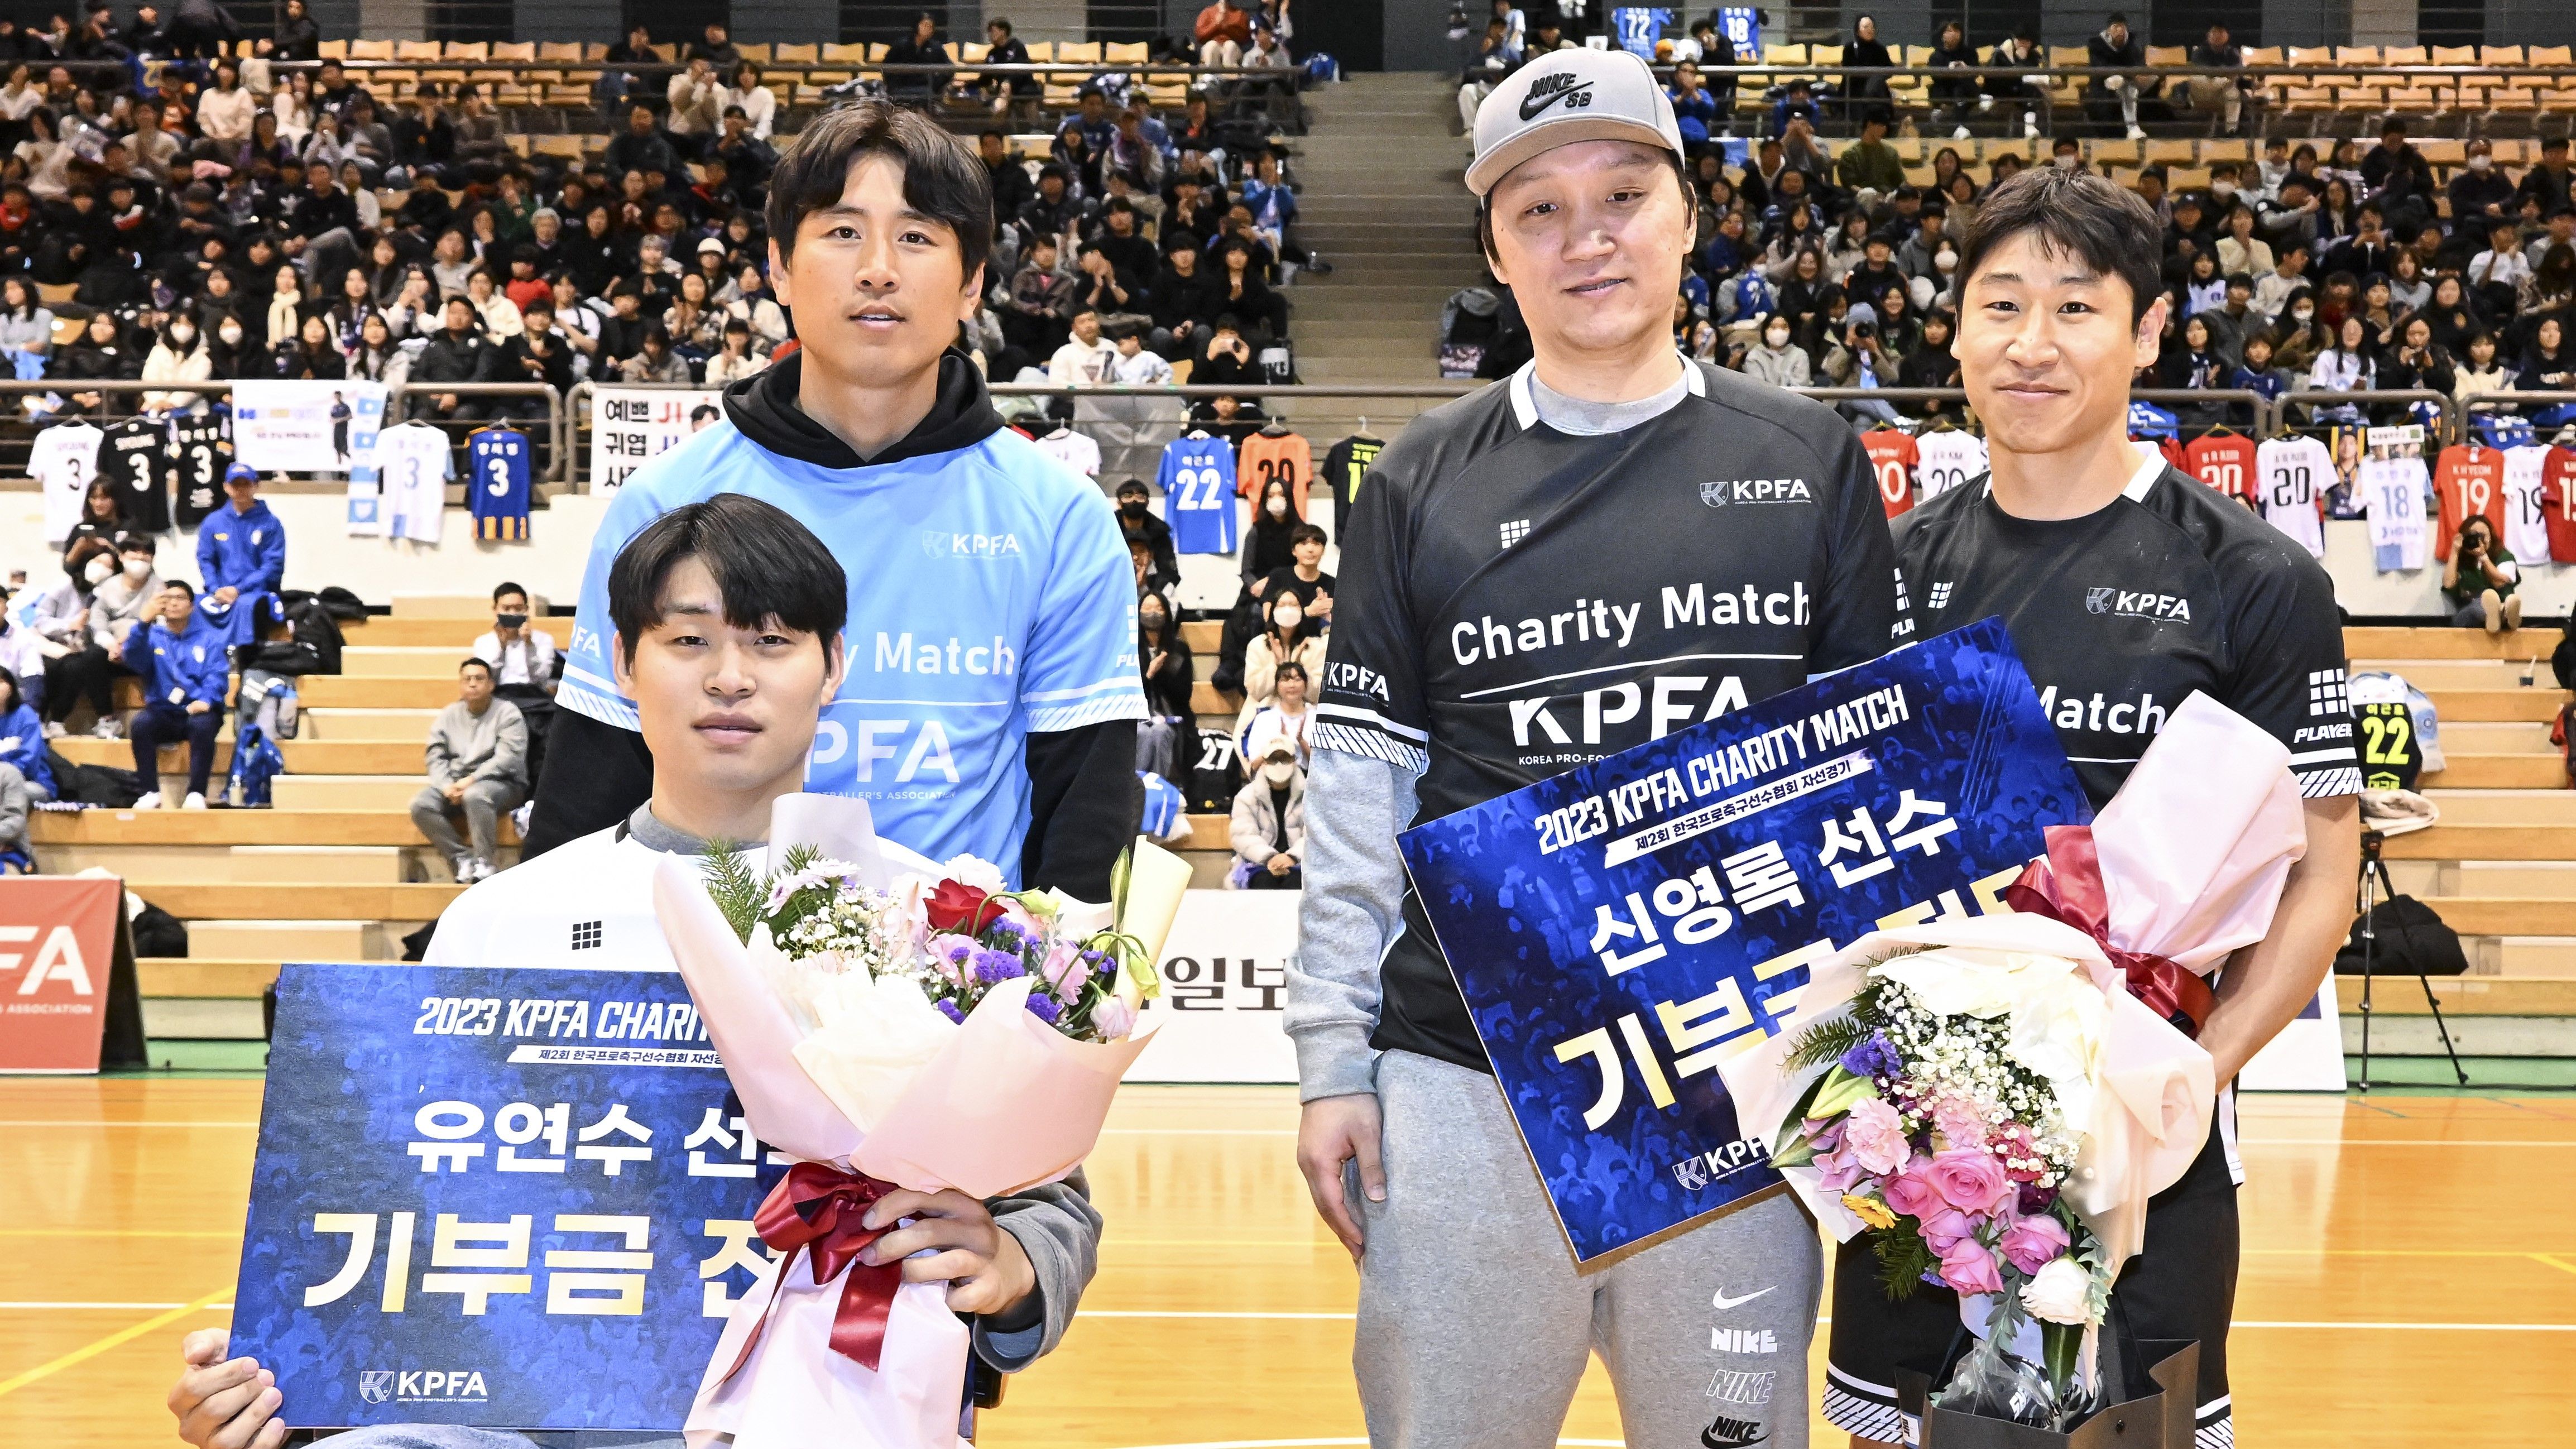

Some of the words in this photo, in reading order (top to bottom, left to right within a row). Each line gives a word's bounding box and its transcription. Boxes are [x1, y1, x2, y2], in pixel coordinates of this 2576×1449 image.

[1726, 17, 1748, 42] 18
[1528, 73, 1576, 99] NIKE
[1565, 92, 1592, 108] SB
[67, 458, 81, 485] 3
[128, 453, 151, 486] 3
[190, 445, 213, 484] 3
[405, 457, 419, 490] 3
[487, 458, 510, 497] 3
[604, 466, 637, 487] 사
[1873, 461, 1906, 503] 0
[2200, 464, 2243, 496] 20
[1176, 468, 1222, 510] 22
[1733, 479, 1811, 500] KPFA
[2274, 467, 2310, 506] 20
[2382, 484, 2409, 519] 18
[2457, 478, 2491, 521] 19
[952, 533, 1020, 555] KPFA
[1452, 598, 1641, 665] Charity
[1661, 581, 1811, 631] Match
[2116, 591, 2190, 620] KPFA
[874, 631, 1015, 675] Match
[1328, 662, 1389, 702] KPFA
[1193, 737, 1233, 771] 27
[2362, 716, 2410, 765] 22
[1519, 755, 1553, 765] KOREA
[1556, 754, 1613, 763] PRO-FO
[1534, 805, 1609, 855] 2023
[1609, 767, 1688, 828] KPFA
[1687, 724, 1807, 797] CHARITY
[1809, 684, 1910, 752] MATCH
[1635, 828, 1670, 851] 제2회
[1673, 780, 1799, 837] 한국프로축구선수협회
[1801, 759, 1852, 788] 자선경기
[1589, 840, 1806, 977] 신영록
[1816, 789, 1959, 890] 선수
[1140, 956, 1287, 1011] 일보
[412, 997, 502, 1036] 2023
[502, 998, 589, 1038] KPFA
[539, 1049, 570, 1060] 제2회
[573, 1050, 688, 1064] 한국프로축구선수협회
[407, 1100, 654, 1176] 유연수
[684, 1107, 793, 1178] 선
[1705, 1135, 1769, 1174] KPF
[303, 1211, 654, 1316] 기부금
[1711, 1327, 1778, 1354] NIKE
[397, 1371, 488, 1395] KPFA
[1706, 1369, 1776, 1404] NIKE
[1710, 1416, 1760, 1442] NIKE
